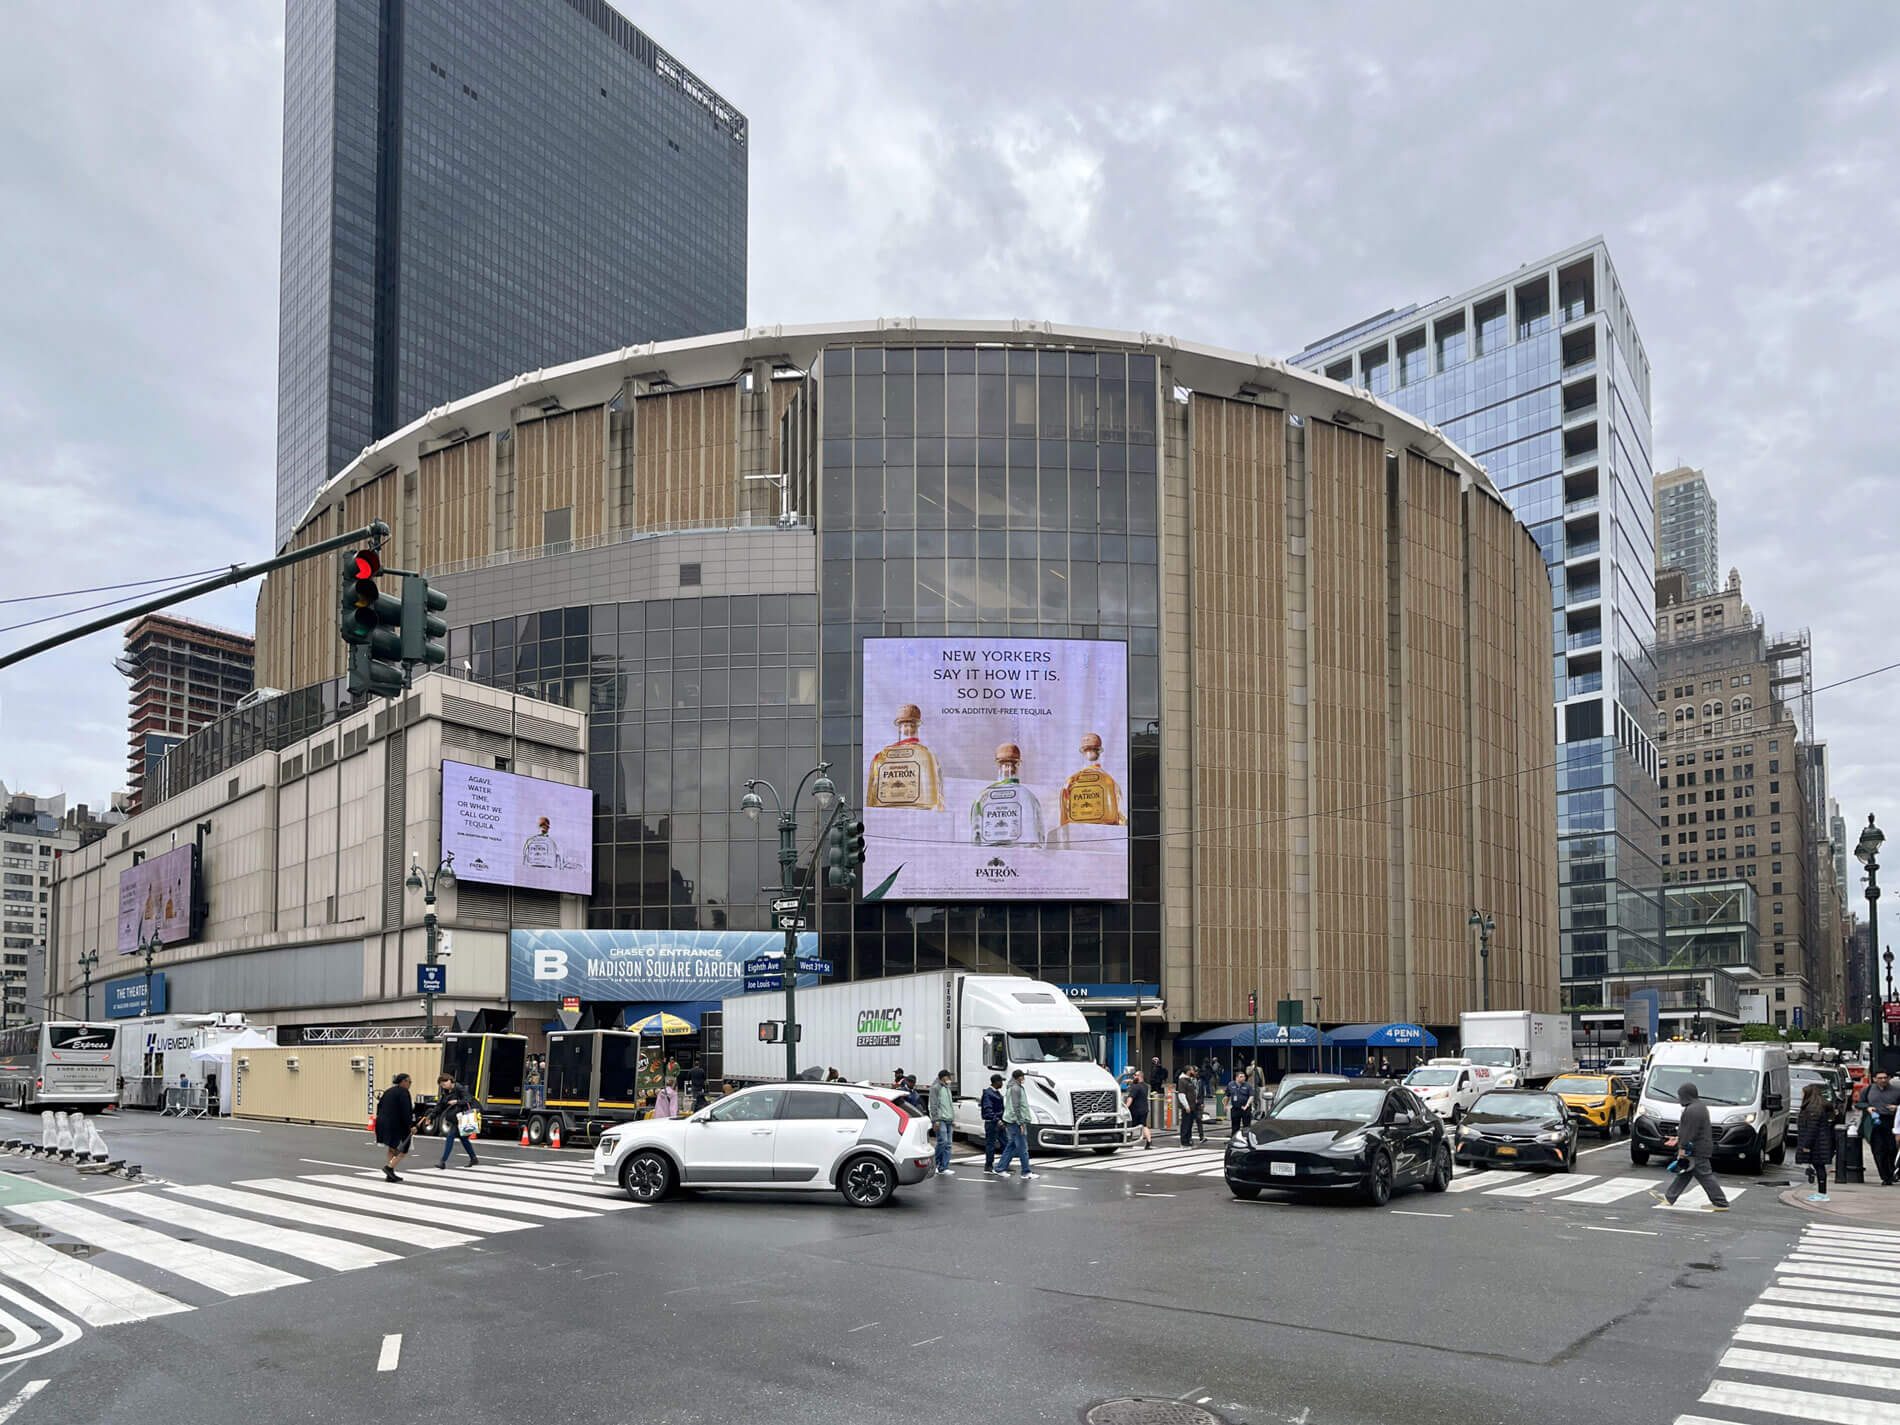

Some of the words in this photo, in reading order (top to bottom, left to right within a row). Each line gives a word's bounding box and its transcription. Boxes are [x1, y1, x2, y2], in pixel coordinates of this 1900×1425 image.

[942, 650, 976, 661] NEW
[982, 650, 1052, 663] YORKERS
[933, 669, 961, 680] SAY
[966, 669, 979, 680] IT
[985, 669, 1021, 681] HOW
[1026, 670, 1039, 681] IT
[1044, 670, 1060, 681] IS.
[958, 688, 979, 699] SO
[983, 688, 1006, 699] DO
[1011, 688, 1036, 700] WE.
[941, 707, 960, 715] 100%
[961, 707, 1018, 715] ADDITIVE-FREE
[1020, 708, 1052, 716] TEQUILA
[883, 769, 915, 779] PATRÓN
[457, 800, 468, 808] OR
[469, 802, 490, 811] WHAT
[460, 810, 477, 818] CALL
[479, 813, 500, 822] GOOD
[609, 948, 644, 957] CHASE
[659, 949, 723, 957] ENTRANCE
[534, 949, 569, 980] B
[587, 958, 642, 977] MADISON
[646, 958, 692, 977] SQUARE
[695, 959, 741, 978] GARDEN
[747, 962, 766, 973] Eighth
[768, 962, 779, 970] Ave
[800, 962, 814, 970] West
[824, 965, 830, 973] St
[747, 981, 756, 989] Joe
[756, 980, 771, 988] Louis
[116, 988, 126, 1000] THE
[856, 1007, 902, 1034] GRMEC
[1276, 1026, 1289, 1037] A
[1386, 1029, 1393, 1038] 4
[1394, 1029, 1420, 1038] PENN
[72, 1041, 108, 1050] Express
[156, 1036, 195, 1050] LIVEMEDIA
